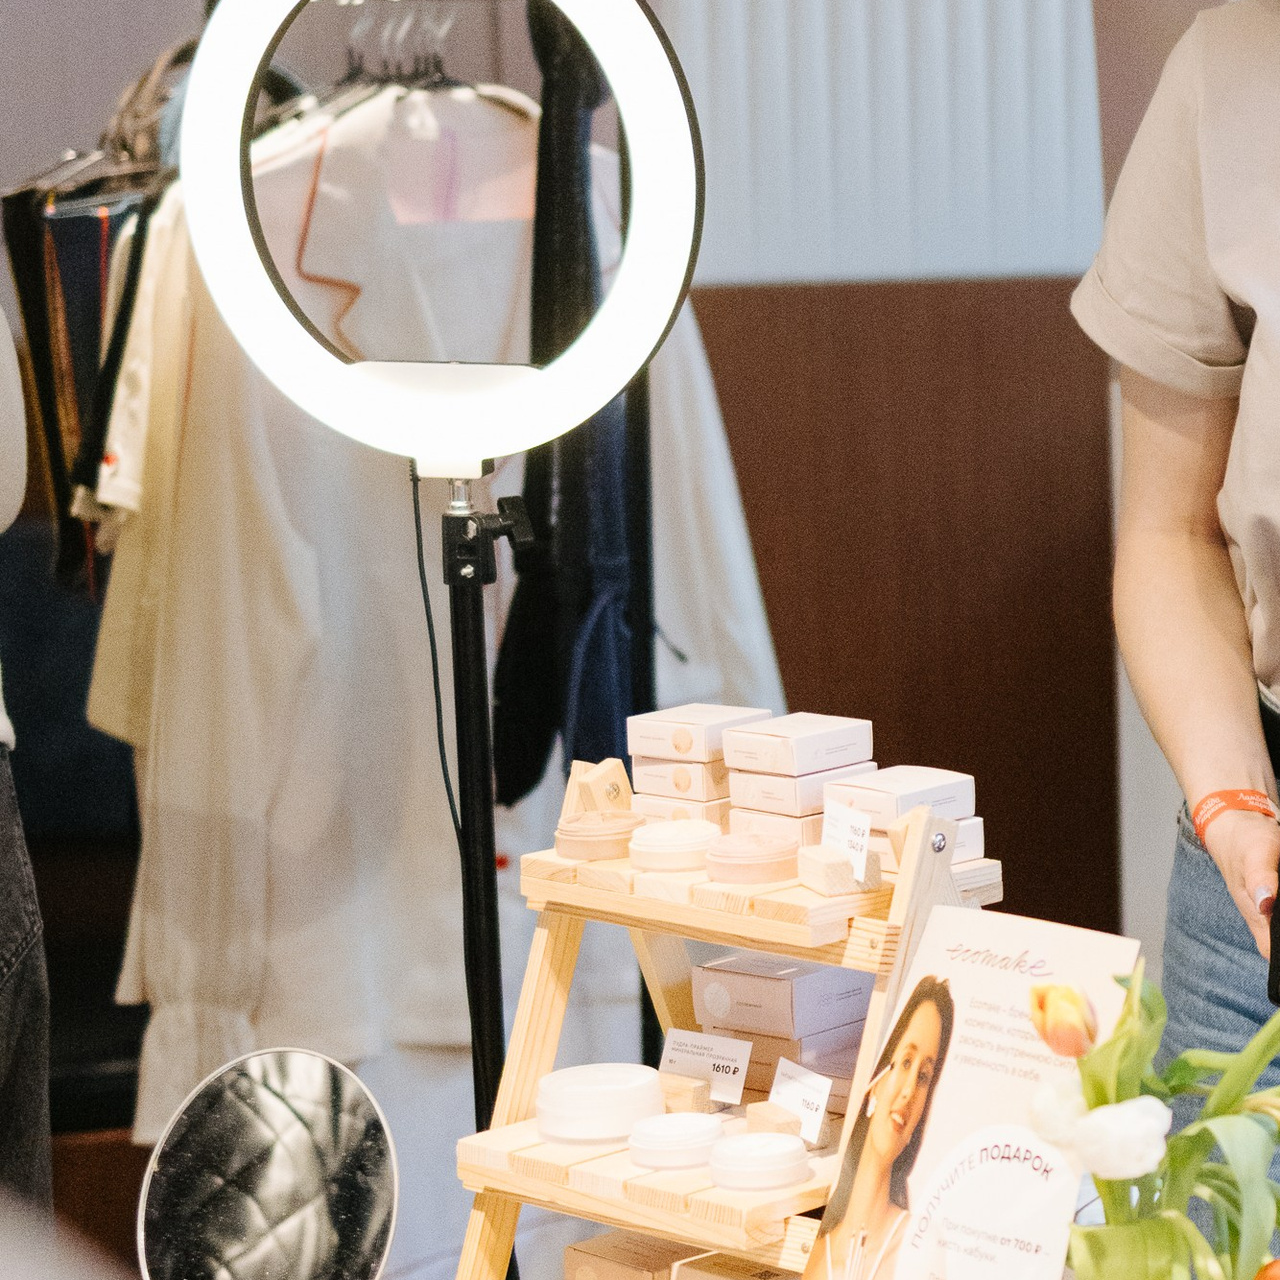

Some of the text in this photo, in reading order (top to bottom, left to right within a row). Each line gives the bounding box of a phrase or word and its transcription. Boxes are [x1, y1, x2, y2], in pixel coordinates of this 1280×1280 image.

[946, 943, 1054, 977] ecomake
[712, 1063, 731, 1075] 1610
[911, 1143, 1054, 1249] ПОЛУЧИТЕ ПОДАРОК
[1000, 1236, 1012, 1247] от
[1013, 1237, 1033, 1253] 700
